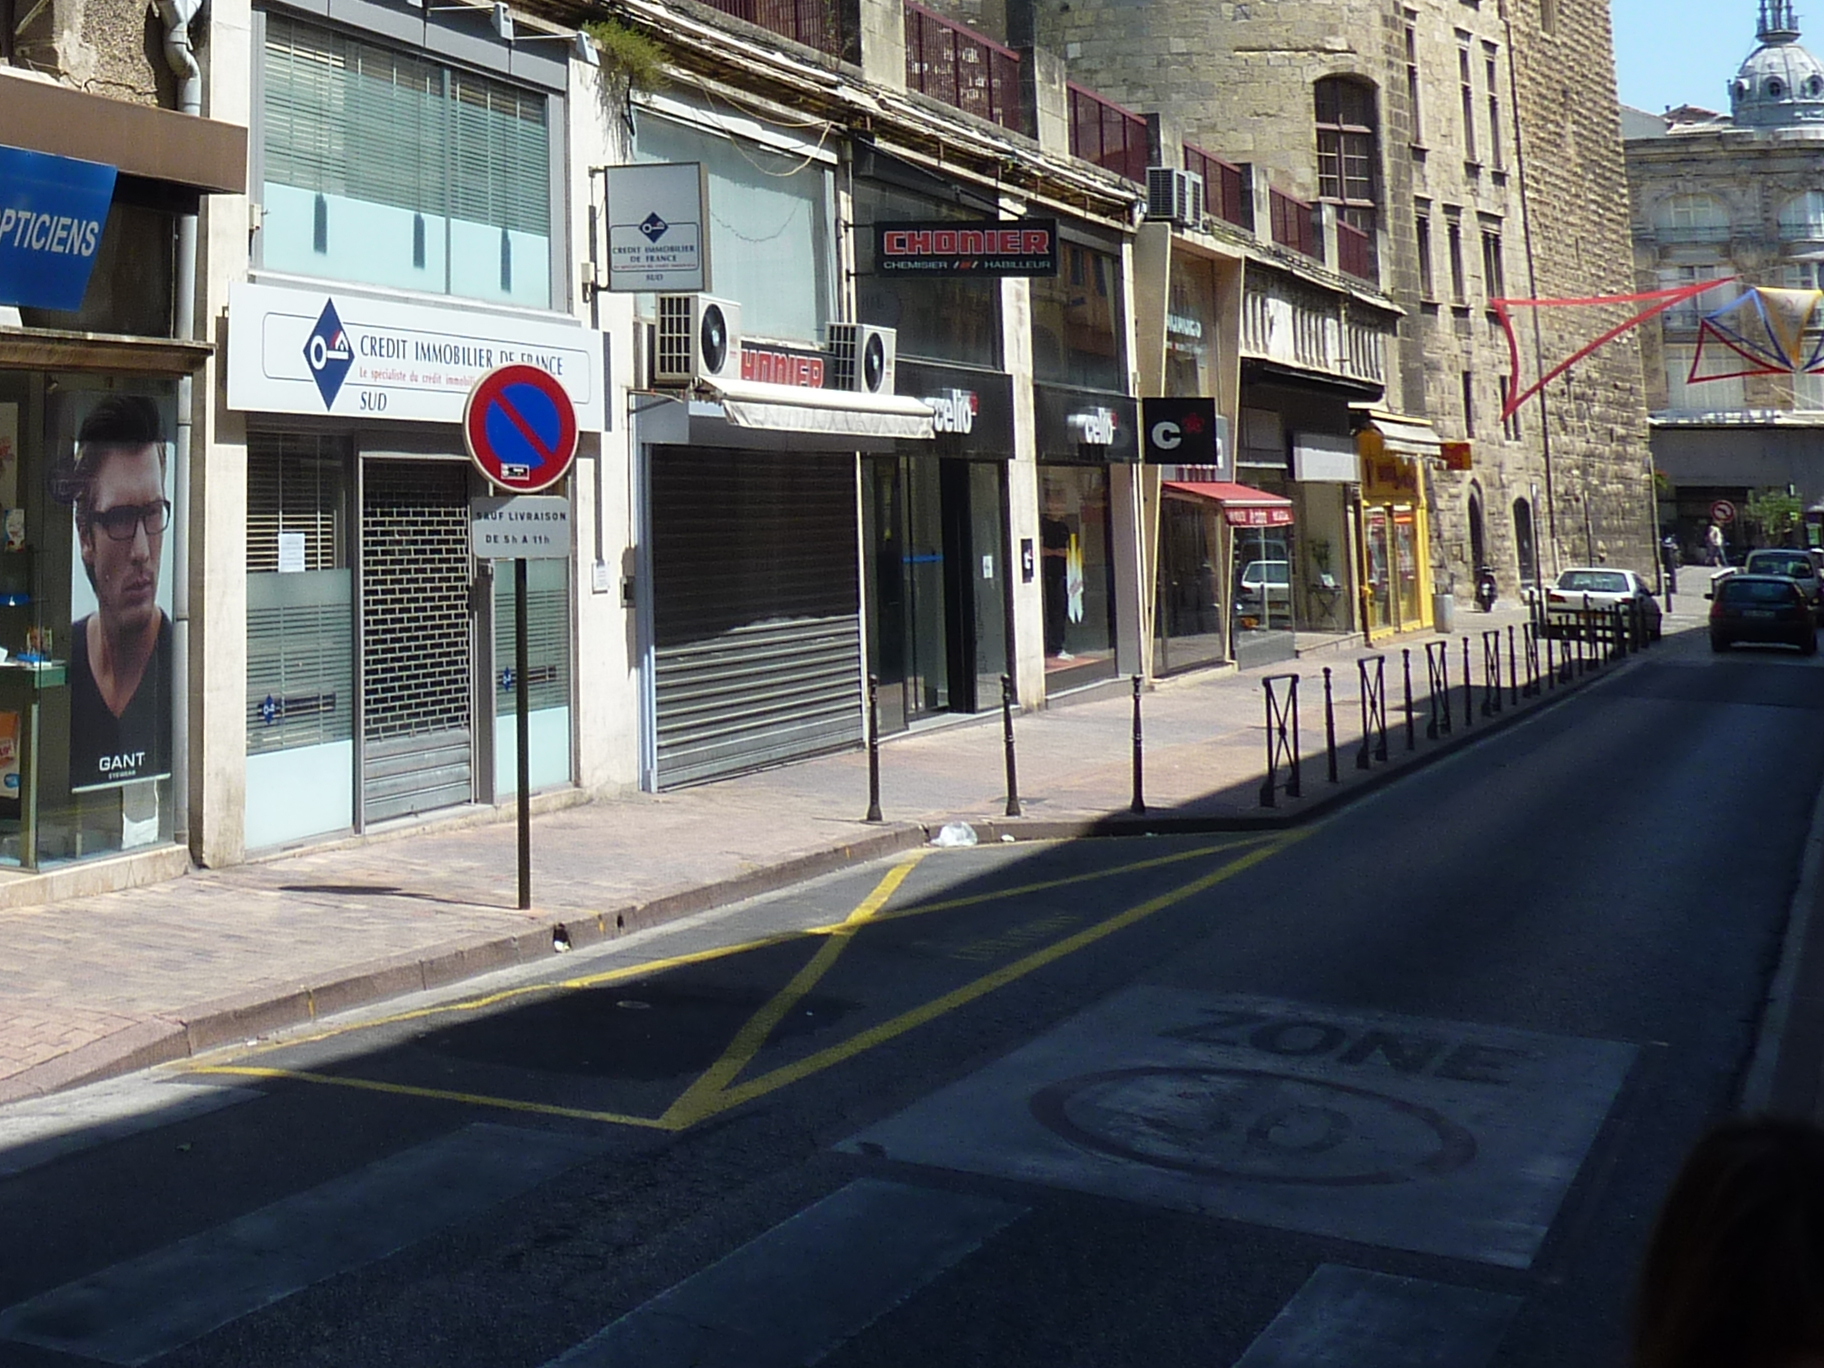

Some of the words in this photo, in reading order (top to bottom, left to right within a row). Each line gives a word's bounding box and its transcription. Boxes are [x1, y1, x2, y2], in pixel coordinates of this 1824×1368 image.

[612, 246, 641, 254] CREDIT
[645, 244, 695, 253] IMMOBILIER
[884, 229, 1050, 255] CHONIER
[630, 255, 641, 263] DE
[646, 255, 677, 263] FRANCE
[883, 260, 948, 270] CHEMISIER
[984, 260, 1051, 269] HABILLEUR
[645, 273, 663, 281] SUD
[360, 334, 408, 360] CREDIT
[415, 340, 494, 369] IMMOBILIER
[500, 350, 515, 366] DE
[359, 366, 368, 378] Le
[409, 370, 418, 382] du
[741, 348, 825, 389] HONIER
[360, 390, 387, 412] SUD
[476, 512, 505, 521] SAUF
[509, 511, 567, 521] LIVRAISON
[485, 534, 499, 544] DE
[522, 534, 529, 544] A
[99, 751, 145, 771] GANT
[1157, 1007, 1530, 1086] ZONE
